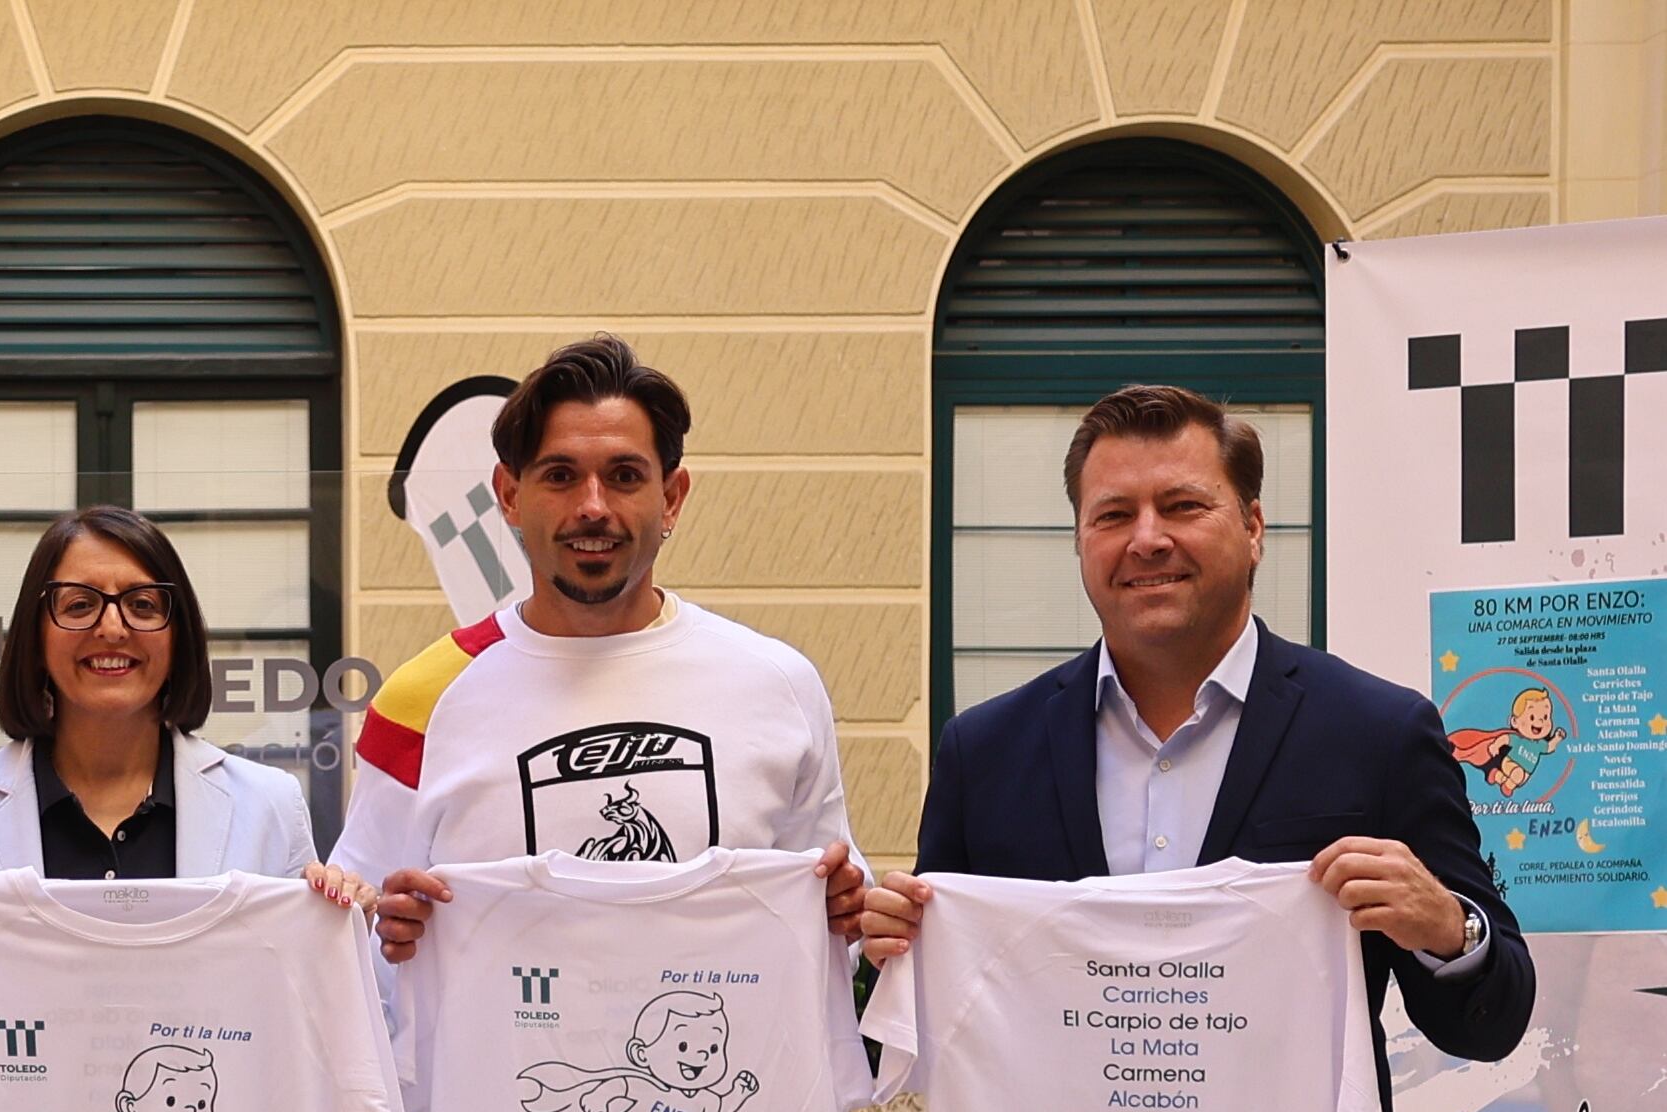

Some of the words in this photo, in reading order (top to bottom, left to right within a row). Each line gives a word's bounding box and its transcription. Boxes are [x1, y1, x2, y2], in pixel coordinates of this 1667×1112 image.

[1474, 599, 1497, 616] 80
[1505, 598, 1532, 614] KM
[1540, 595, 1579, 612] POR
[1587, 590, 1645, 610] ENZO:
[1468, 620, 1492, 633] UNA
[1496, 617, 1552, 632] COMARCA
[1557, 617, 1572, 628] EN
[1576, 612, 1652, 627] MOVIMIENTO
[1497, 637, 1506, 645] 27
[1508, 637, 1518, 645] DE
[1514, 646, 1539, 656] Salida
[1541, 646, 1563, 654] desde
[1565, 645, 1573, 654] la
[1575, 645, 1596, 654] plaza
[1527, 658, 1536, 667] de
[1538, 658, 1561, 666] Santa
[1563, 657, 1587, 665] Olalla
[1587, 667, 1614, 676] Santa
[1617, 665, 1646, 675] Olalla
[1593, 679, 1641, 689] Carriches
[1583, 694, 1615, 703] Carpio
[1631, 690, 1653, 701] Tajo
[1598, 705, 1611, 714] La
[1613, 704, 1636, 713] Mata
[1595, 717, 1639, 727] Carmena
[1567, 743, 1582, 753] Val
[1583, 743, 1595, 752] de
[1597, 742, 1625, 751] Santo
[1600, 767, 1637, 777] Portillo
[1591, 780, 1645, 790] Fuensalida
[1599, 793, 1638, 803] Torrijos
[1594, 805, 1643, 815] Gerindote
[1529, 817, 1575, 838] ENZO
[1592, 816, 1645, 828] Escalonilla
[1519, 862, 1547, 872] CORRE,
[1550, 861, 1584, 870] PEDALEA
[1587, 860, 1594, 868] O
[1596, 858, 1642, 869] ACOMPAÑA
[1514, 875, 1532, 885] ESTE
[1535, 873, 1594, 884] MOVIMIENTO
[1597, 871, 1650, 883] SOLIDARIO.
[1087, 961, 1150, 978] Santa
[1158, 962, 1224, 978] Olalla
[661, 970, 689, 983] Por
[693, 971, 705, 982] ti
[708, 970, 722, 983] la
[726, 970, 759, 983] luna
[1103, 986, 1208, 1004] Carriches
[515, 1011, 560, 1020] TOLEDO
[1064, 1010, 1079, 1026] El
[1087, 1011, 1162, 1032] Carpio
[1169, 1014, 1199, 1030] de
[1206, 1013, 1248, 1033] tajo
[150, 1023, 179, 1037] Por
[183, 1026, 195, 1038] ti
[198, 1026, 212, 1039] la
[217, 1027, 252, 1041] luna
[1111, 1039, 1134, 1055] La
[1143, 1039, 1199, 1056] Mata
[0, 1064, 47, 1073] TOLEDO
[1103, 1064, 1205, 1082] Carmena
[0, 1074, 47, 1083] Diputación
[1108, 1091, 1198, 1108] Alcabón
